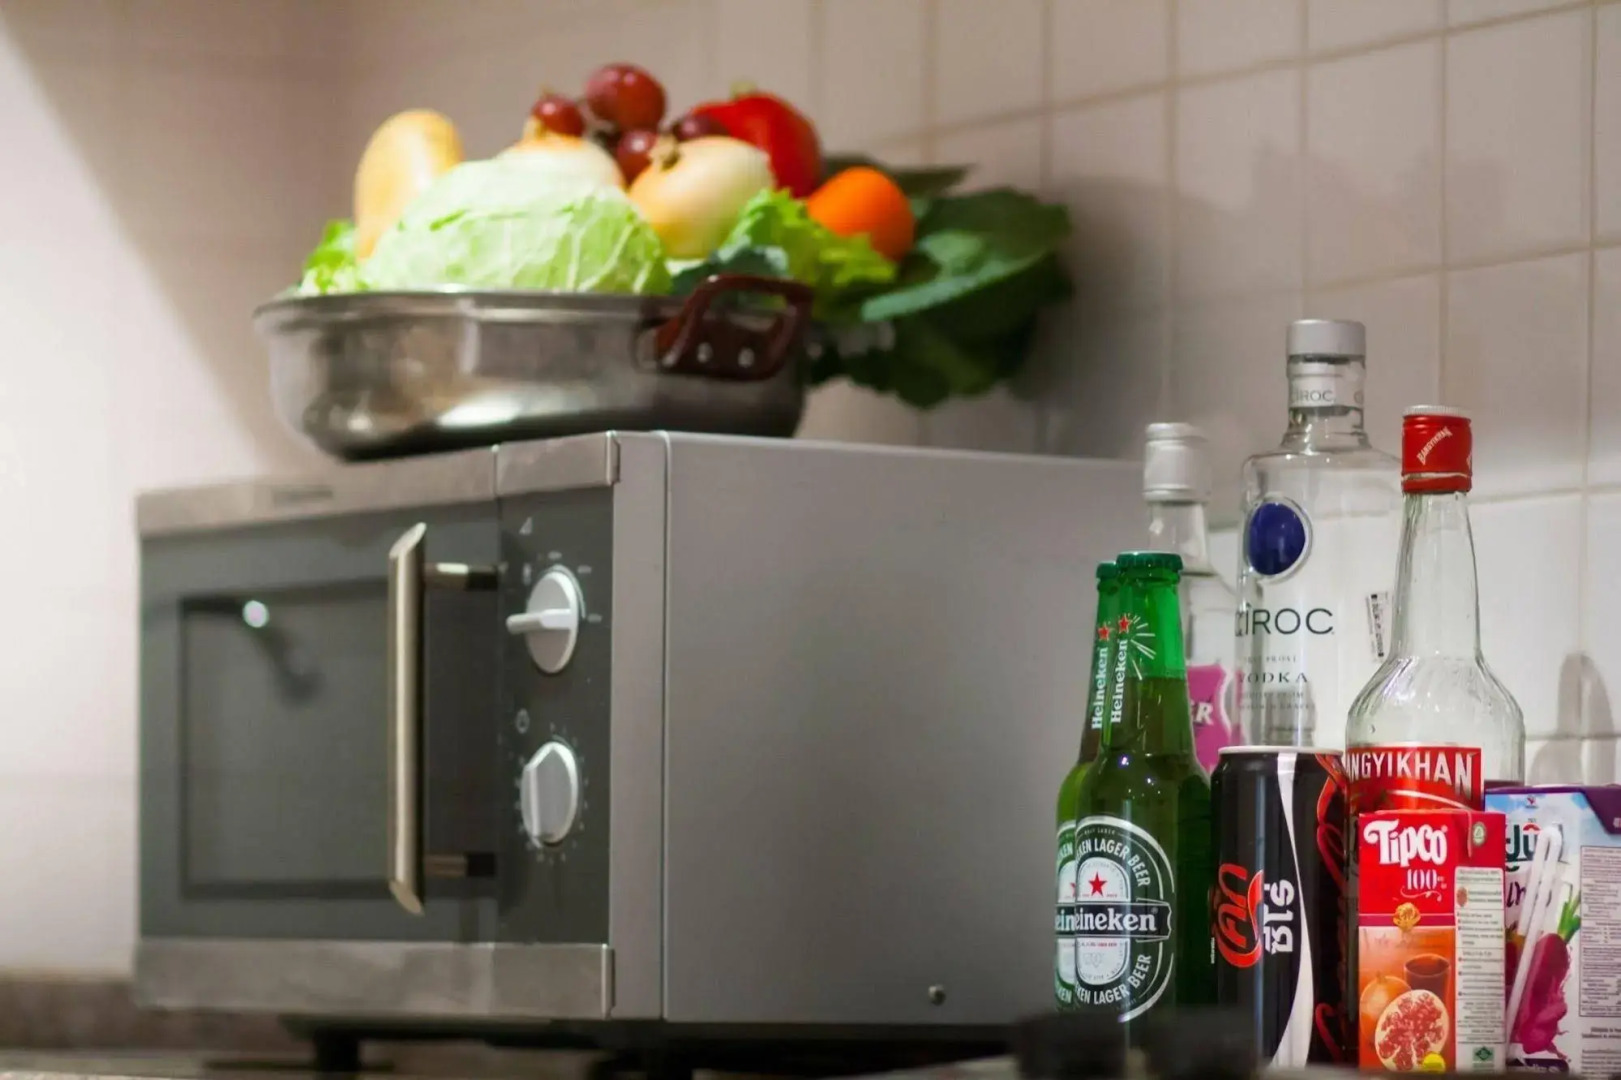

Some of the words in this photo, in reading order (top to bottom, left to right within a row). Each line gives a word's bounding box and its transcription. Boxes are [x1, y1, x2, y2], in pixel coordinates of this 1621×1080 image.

[1091, 647, 1108, 730] Heineken
[1110, 639, 1128, 723] Heineken
[1094, 838, 1130, 860] LAGER
[1127, 854, 1151, 887] BEER
[1076, 907, 1157, 932] eineken
[1093, 983, 1130, 1005] LAGER
[1127, 953, 1152, 989] BEER
